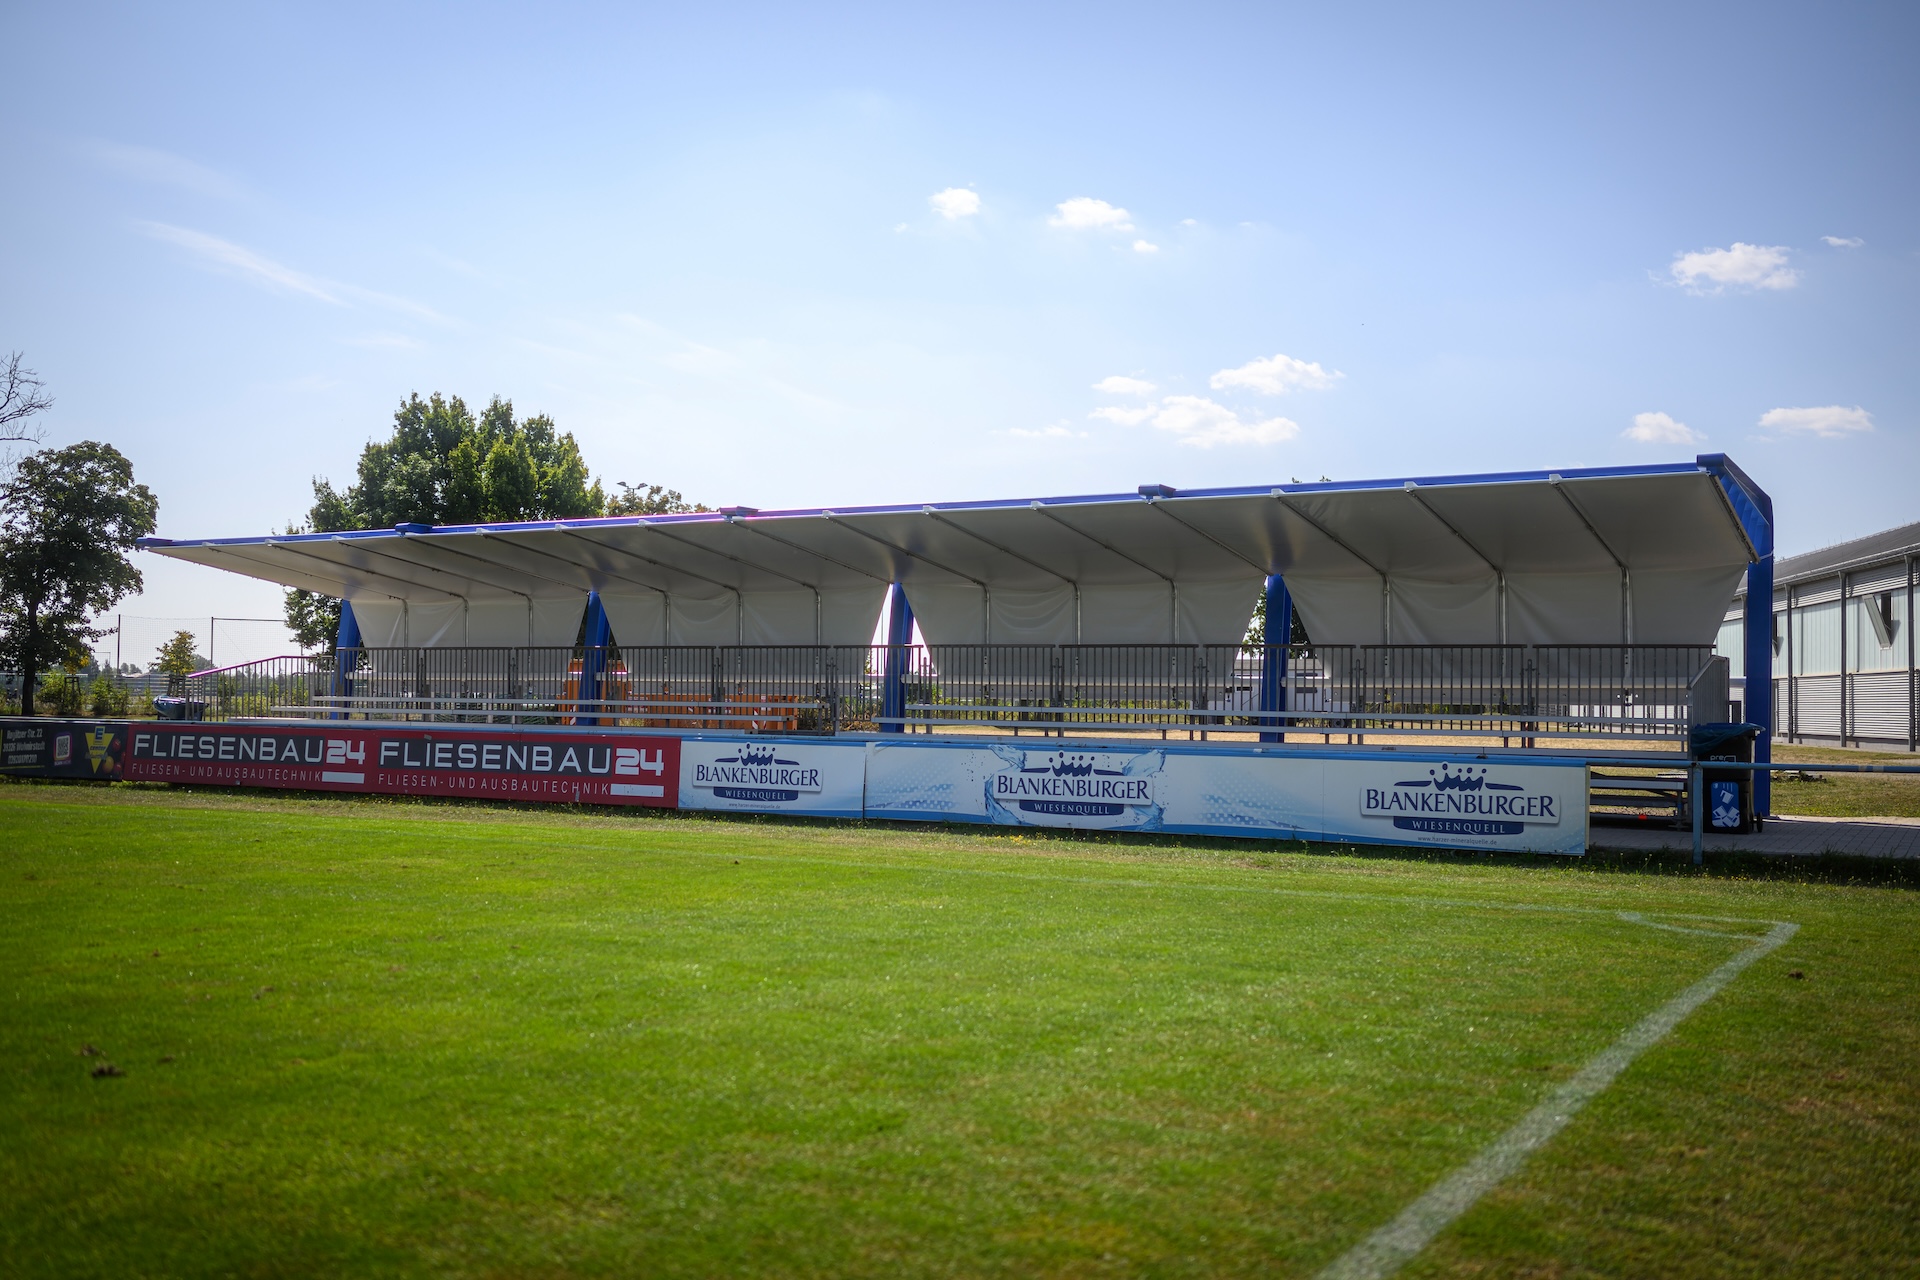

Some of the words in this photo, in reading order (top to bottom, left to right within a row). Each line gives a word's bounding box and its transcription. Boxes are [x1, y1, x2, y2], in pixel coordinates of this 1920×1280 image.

[133, 733, 365, 766] FLIESENBAU24
[380, 741, 665, 776] FLIESENBAU24
[189, 765, 213, 776] UND
[216, 766, 323, 782] AUSBAUTECHNIK
[696, 765, 820, 786] BLANKENBURGER
[449, 776, 476, 789] UND
[480, 778, 610, 795] AUSBAUTECHNIK
[725, 789, 787, 801] WIESENQUELL
[998, 775, 1150, 799] BLANKENBURGER
[1034, 803, 1109, 816] WIESENQUELL
[1366, 788, 1557, 818] BLANKENBURGER
[1412, 820, 1506, 835] WIESENQUELL
[1417, 836, 1498, 846] www.harzer-mineralquelle.de
